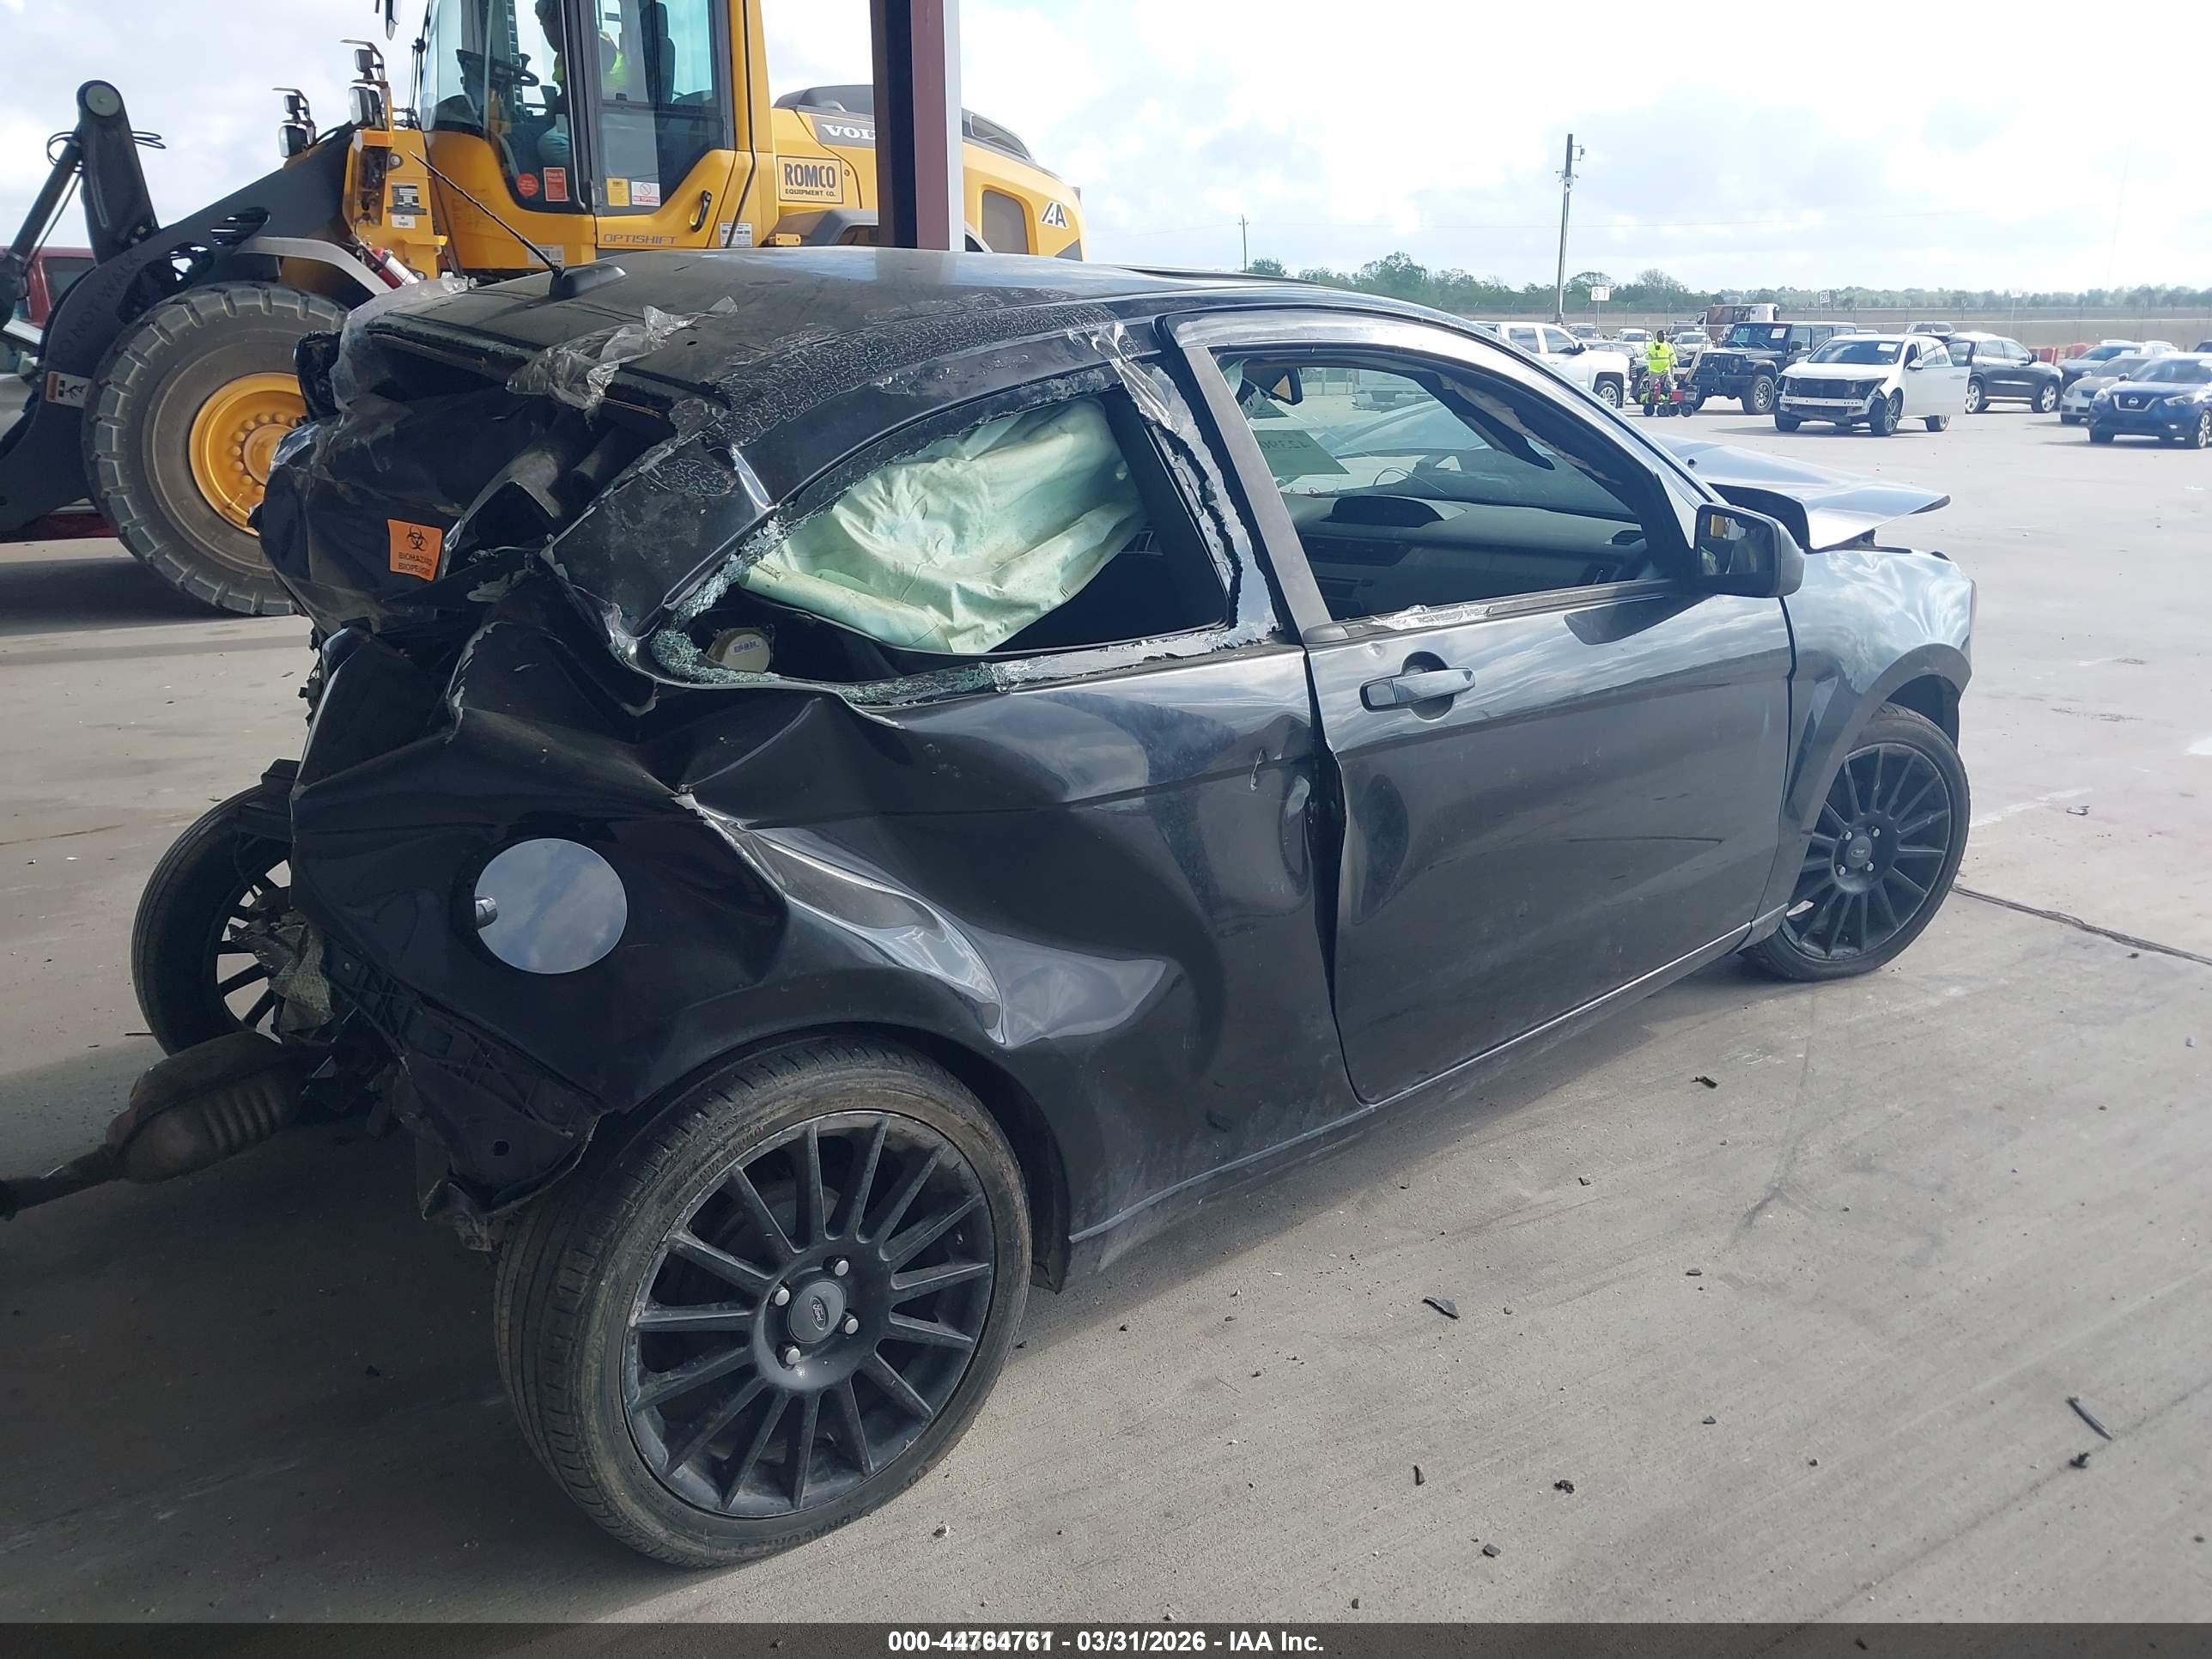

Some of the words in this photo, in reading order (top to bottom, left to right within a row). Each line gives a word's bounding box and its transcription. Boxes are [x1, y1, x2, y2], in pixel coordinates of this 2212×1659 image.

[821, 124, 876, 141] VOL
[784, 163, 836, 188] ROMCO
[785, 188, 823, 197] EQUIPMENT
[604, 234, 678, 245] OPTISHIFT
[1820, 293, 1829, 302] 20
